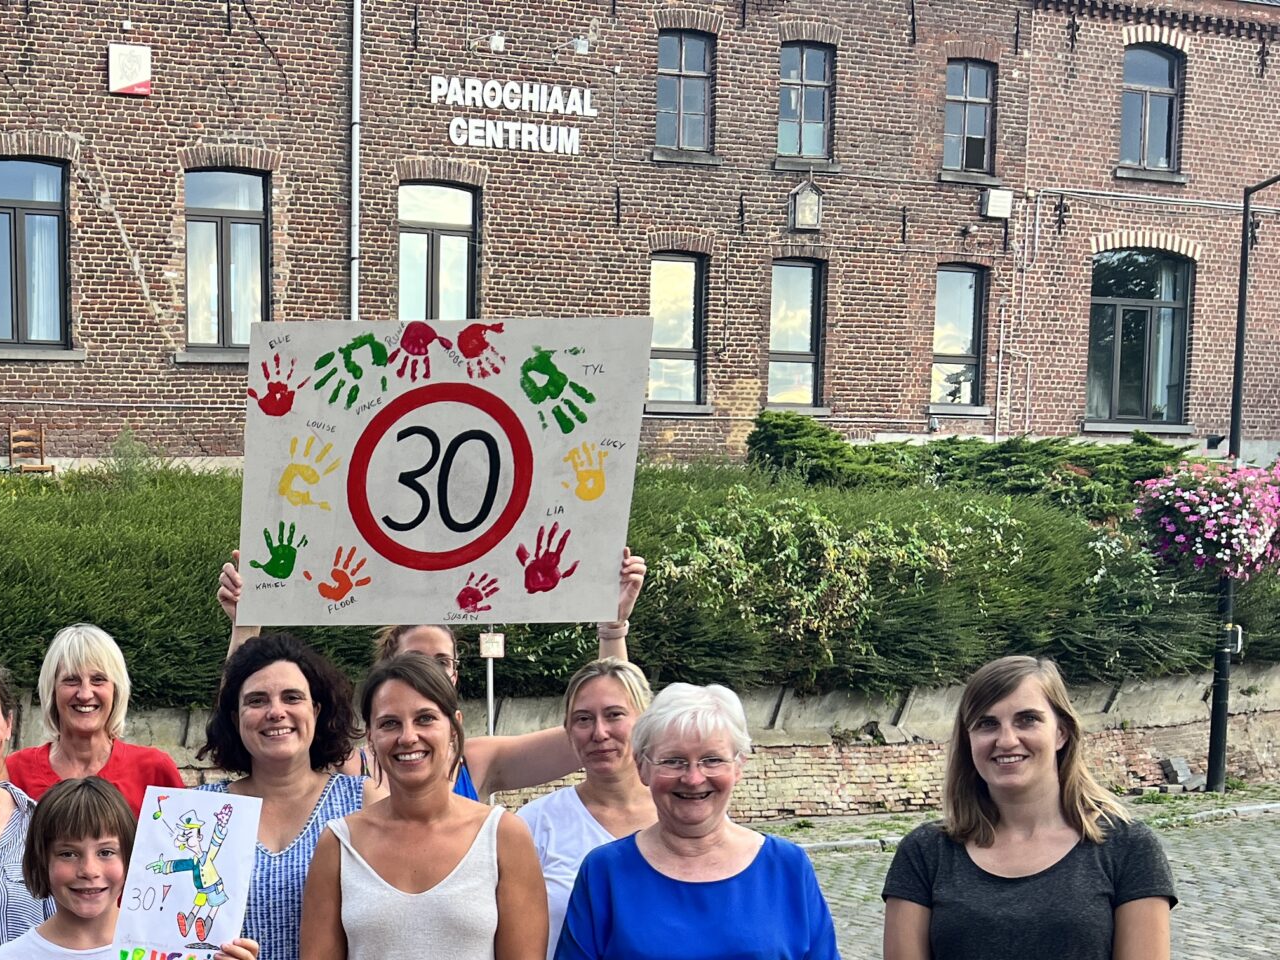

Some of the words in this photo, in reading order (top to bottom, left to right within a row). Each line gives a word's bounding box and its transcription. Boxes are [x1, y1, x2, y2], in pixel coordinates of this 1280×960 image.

[430, 75, 598, 117] PAROCHIAAL
[449, 116, 580, 155] CENTRUM
[268, 334, 291, 350] ELLIE
[582, 363, 605, 376] TYL
[355, 396, 382, 416] VINCE
[306, 420, 337, 433] LOUISE
[600, 437, 626, 450] LUCY
[381, 425, 501, 533] 30
[546, 505, 565, 517] LIA
[327, 595, 357, 614] FLOOR
[443, 611, 480, 621] SUSAN
